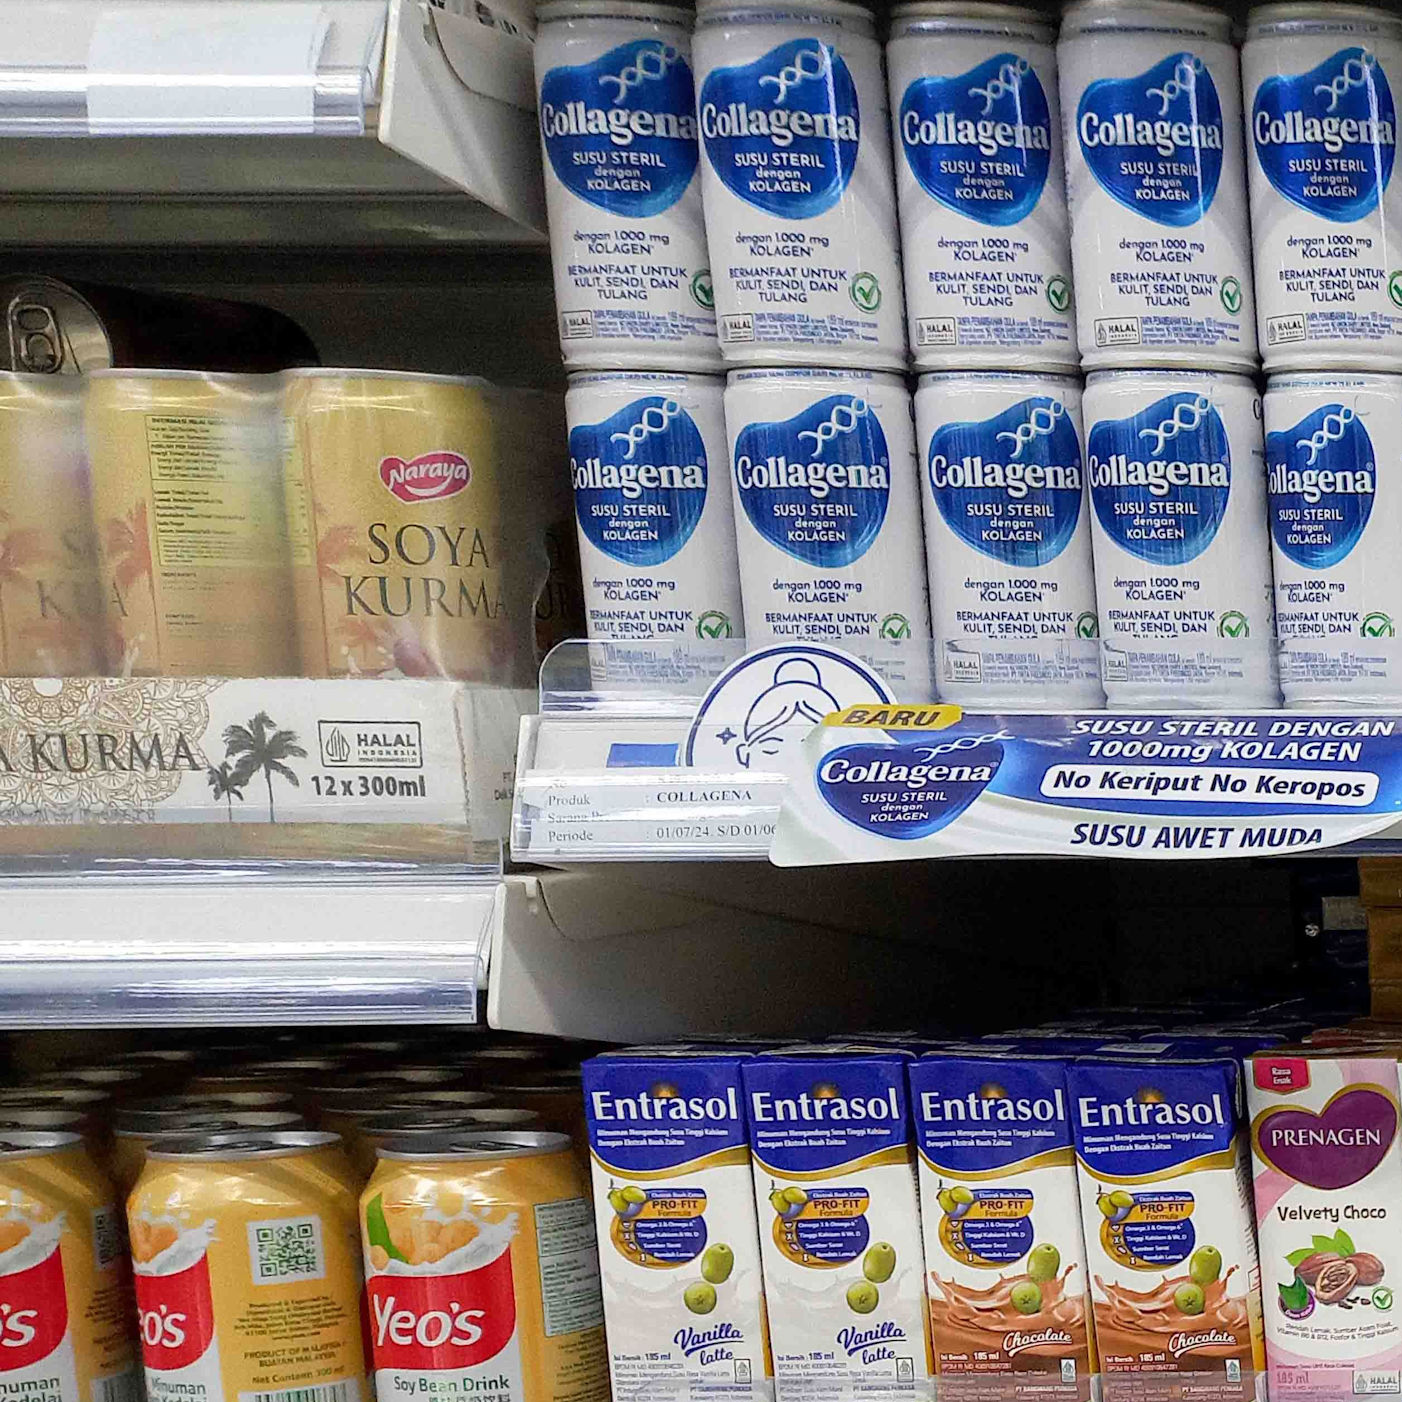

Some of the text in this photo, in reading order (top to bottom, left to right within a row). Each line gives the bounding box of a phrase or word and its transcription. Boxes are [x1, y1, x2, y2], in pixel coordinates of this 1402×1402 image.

[701, 104, 858, 146] Collagena
[735, 155, 825, 168] SUSU STERIL
[749, 181, 811, 194] KOLAGEN
[729, 268, 847, 281] BERMANFAAT UNTUK
[758, 289, 808, 303] TULANG
[389, 458, 468, 494] Naraya
[368, 523, 489, 567] SOYA
[840, 706, 941, 728] BARU
[357, 732, 416, 749] HALAL
[1074, 718, 1394, 740] SUSU STERIL DENGAN
[30, 732, 204, 772] KURMA
[1089, 740, 1362, 765] 1000mg KOLAGEN
[819, 754, 995, 789] Collagena
[311, 775, 426, 798] 12 x 300ml
[549, 790, 752, 806] Produk COLLAGENA
[1053, 769, 1367, 804] No Keriput No Keropos
[549, 830, 593, 842] Periode
[1072, 823, 1323, 849] SUSU AWET MUDA
[592, 1088, 738, 1123] Entrasol
[1079, 1095, 1223, 1128] Entrasol
[1271, 1127, 1381, 1148] PRENAGEN
[979, 1200, 1025, 1210] PRO-FIT
[372, 1294, 484, 1348] Yeo's
[673, 1327, 744, 1350] Vanilla
[1167, 1330, 1236, 1354] Chocolate
[699, 1349, 735, 1365] latte
[393, 1375, 511, 1395] Soy Bean Drink
